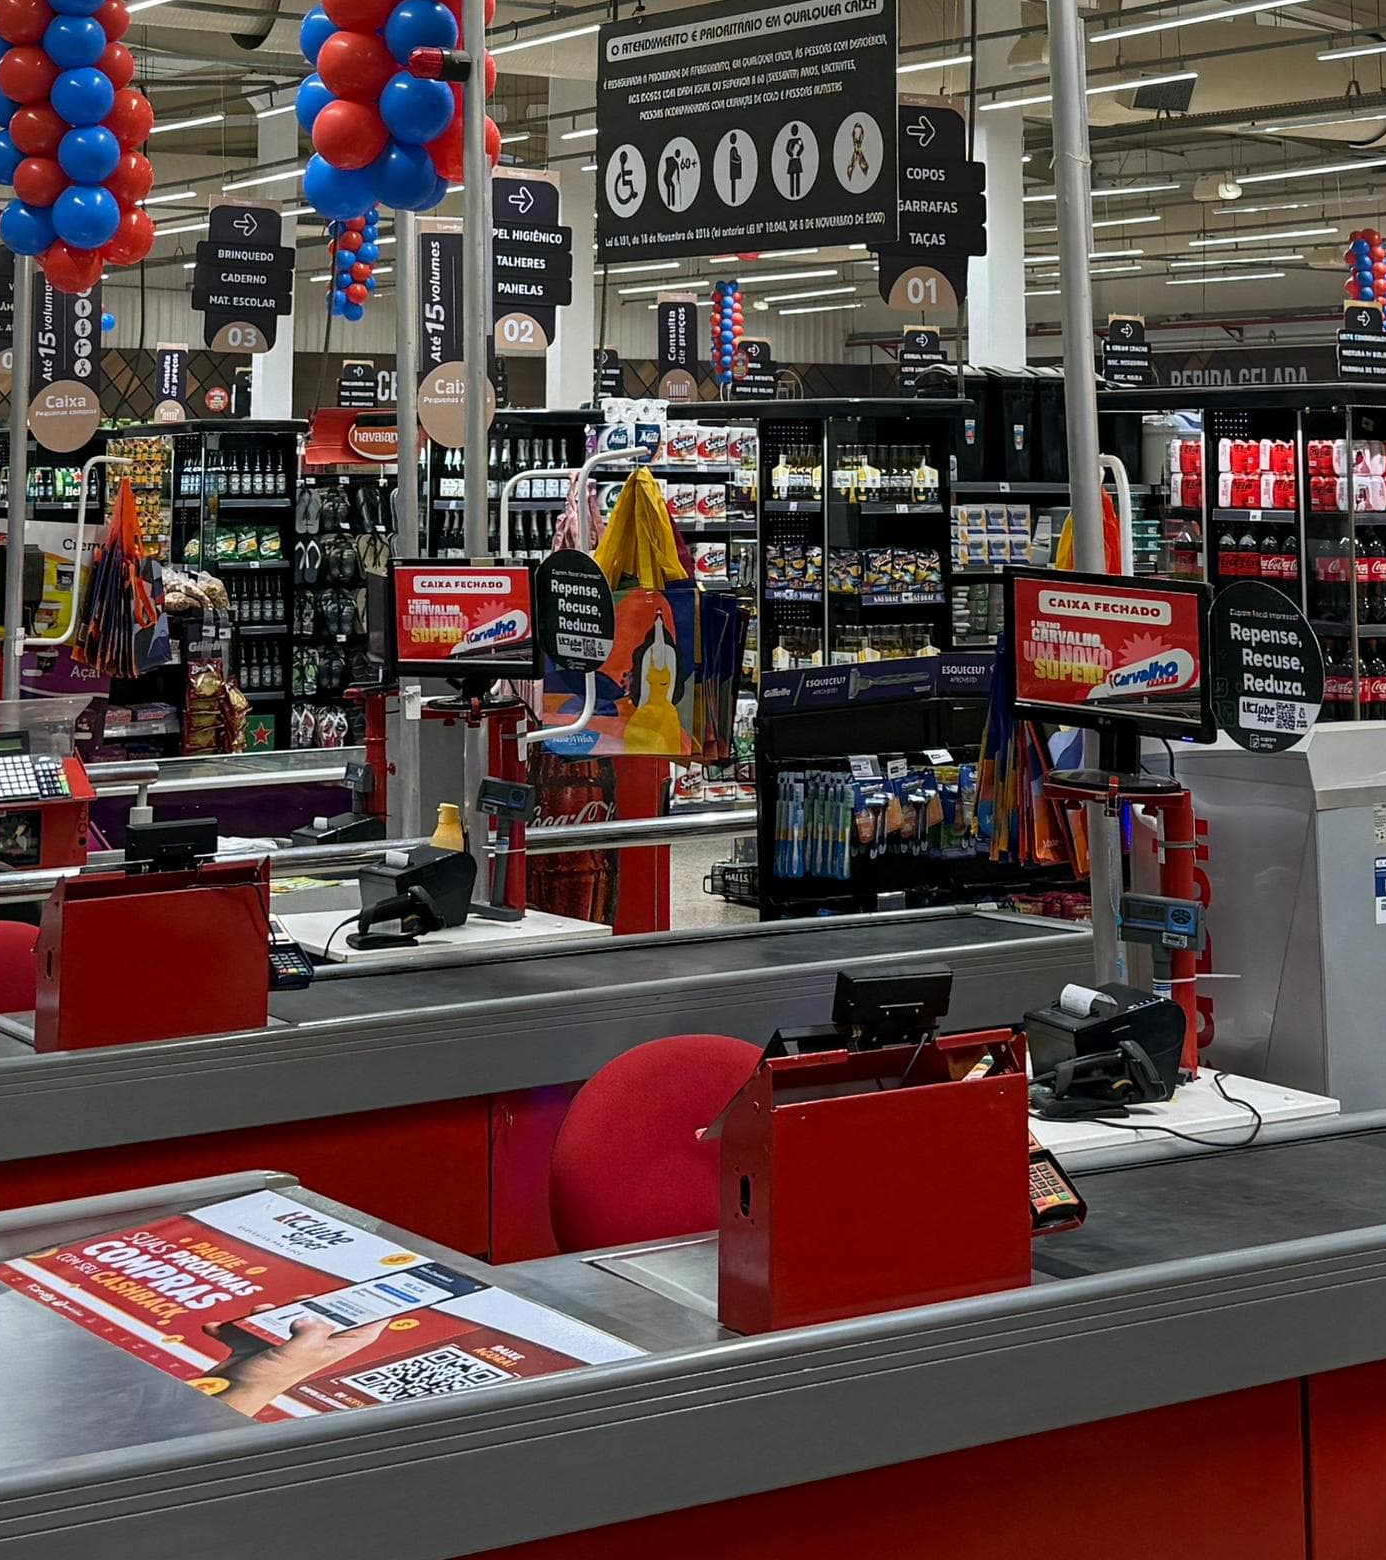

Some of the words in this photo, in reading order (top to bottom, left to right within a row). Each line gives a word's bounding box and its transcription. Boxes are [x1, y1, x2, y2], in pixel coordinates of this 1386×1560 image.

[612, 45, 619, 56] O
[622, 33, 688, 55] ATENDIMENTO
[700, 16, 762, 41] PRIORITÁRIO
[766, 16, 781, 27] EM
[784, 4, 841, 26] QUALQUER
[681, 159, 697, 170] 60+
[907, 168, 945, 181] COPOS
[899, 200, 958, 213] GARRAFAS
[513, 228, 562, 244] HIGIÊNICO
[909, 233, 946, 247] TAÇAS
[218, 250, 274, 262] BRINQUEDO
[496, 256, 545, 269] TALHERES
[221, 273, 267, 284] CADERNO
[432, 241, 440, 301] volumes
[498, 283, 543, 295] PANELAS
[908, 277, 937, 304] 01
[210, 296, 230, 306] MAT.
[233, 297, 275, 308] ESCOLAR
[425, 303, 445, 333] 15
[678, 307, 686, 346] preços
[228, 328, 257, 347] 03
[504, 320, 534, 343] 02
[667, 311, 676, 361] Consulta
[39, 332, 56, 356] 15
[430, 337, 441, 362] Até
[678, 349, 686, 364] de
[43, 360, 52, 381] Até
[162, 355, 170, 394] Consulta
[46, 396, 86, 408] Caixa
[455, 581, 503, 589] FECHADO
[551, 579, 601, 599] Repense,
[558, 599, 601, 618] Recuse,
[1049, 598, 1091, 610] CAIXA
[1095, 603, 1161, 617] FECHADO
[411, 628, 463, 643] SUPER!
[559, 617, 602, 634] Reduza.
[1230, 622, 1302, 648] Repense,
[1031, 628, 1104, 649] CARVALHO,
[1064, 644, 1113, 670] NOVO
[1242, 648, 1304, 673] Recuse,
[942, 666, 985, 674] ESQUECEU?
[1034, 658, 1104, 684] SUPER!
[1114, 660, 1178, 687] Carvalho
[805, 677, 846, 688] ESQUECEU?
[1243, 673, 1305, 696] Reduza.
[725, 872, 750, 882] HALLS
[124, 1232, 177, 1255] SUAS
[282, 1231, 330, 1251] Super
[190, 1243, 247, 1268] PAGUE
[82, 1241, 233, 1310] COMPRAS
[90, 1271, 188, 1320] CASHBACK
